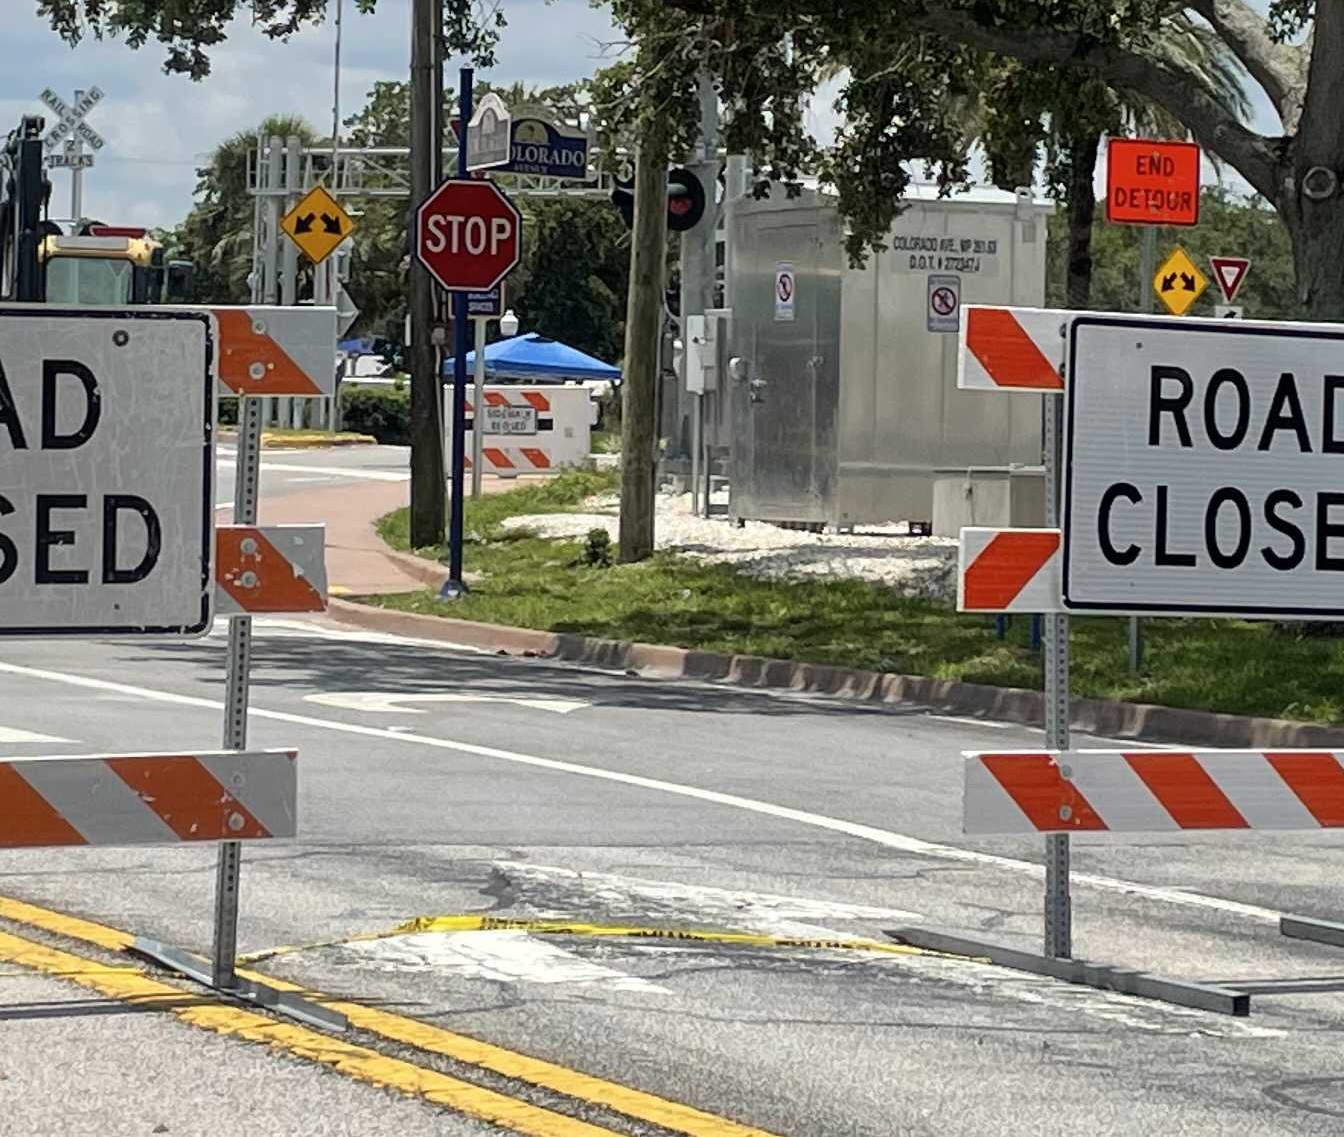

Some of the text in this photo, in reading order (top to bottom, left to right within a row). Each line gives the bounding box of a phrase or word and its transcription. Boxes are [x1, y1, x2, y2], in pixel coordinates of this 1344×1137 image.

[44, 89, 101, 149] CROSSING
[512, 145, 585, 167] LORADO
[1136, 155, 1175, 177] END
[1114, 187, 1193, 212] DETOUR
[425, 214, 512, 256] STOP
